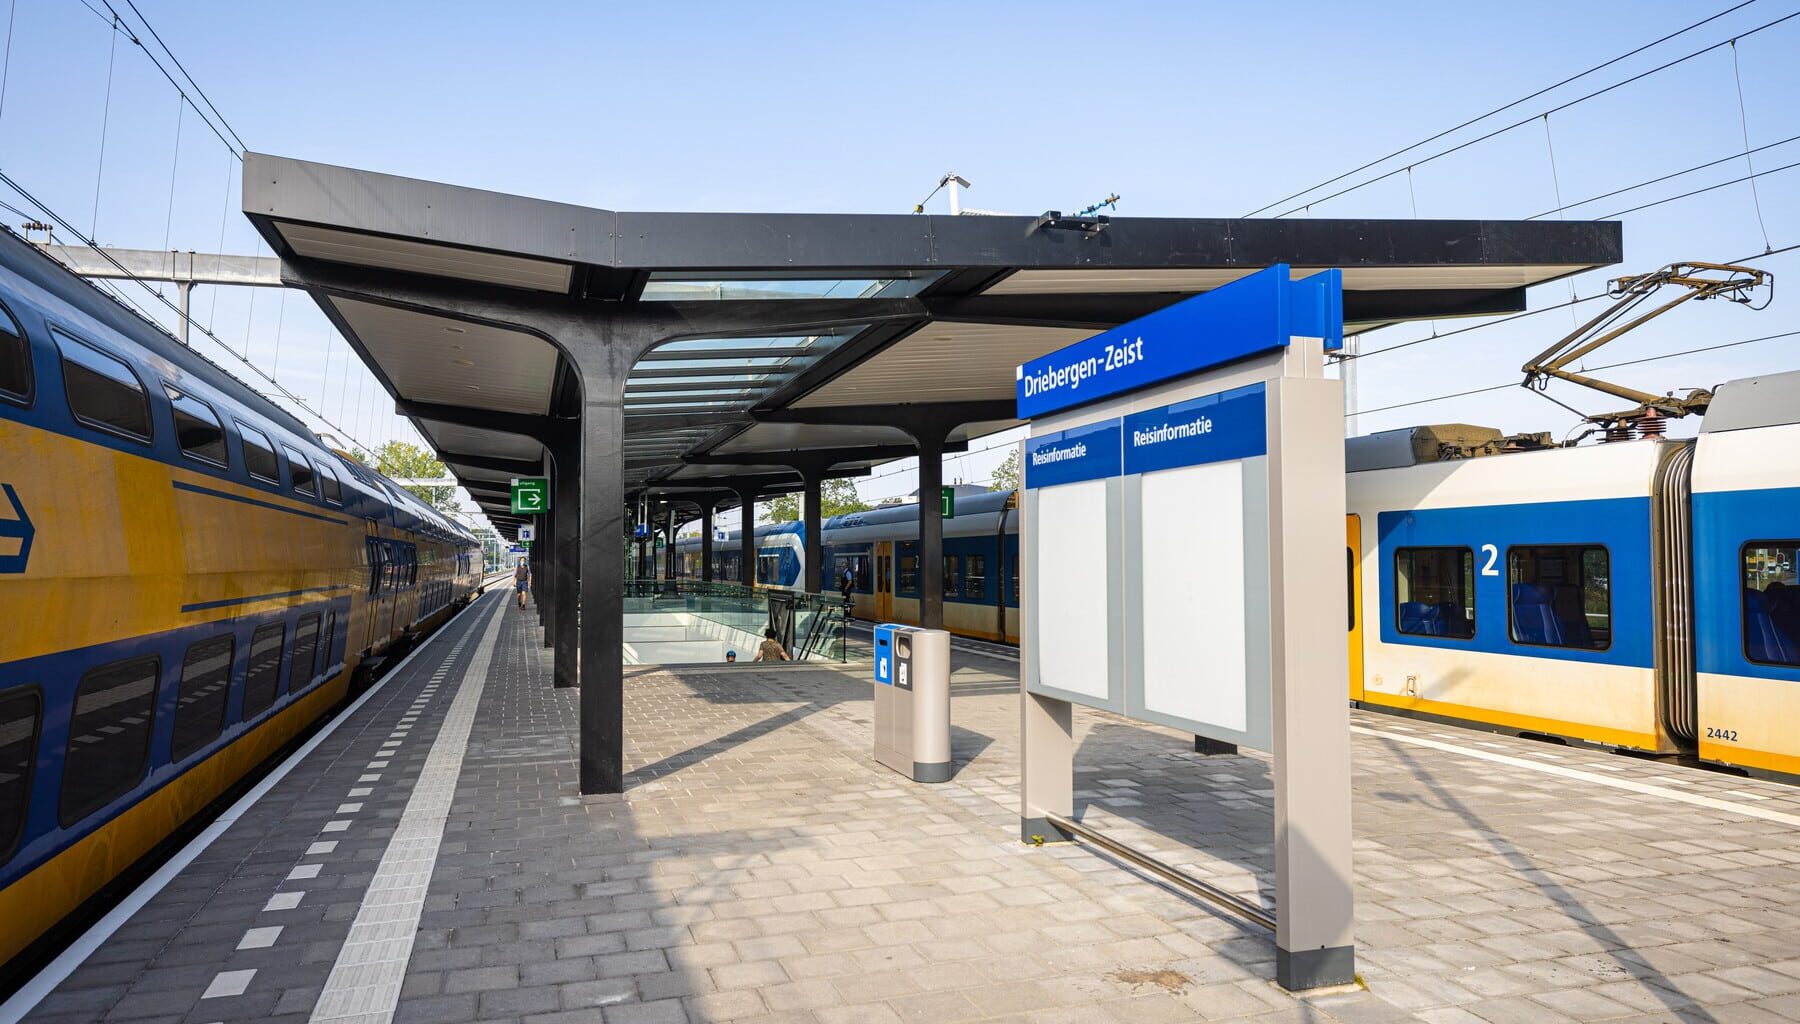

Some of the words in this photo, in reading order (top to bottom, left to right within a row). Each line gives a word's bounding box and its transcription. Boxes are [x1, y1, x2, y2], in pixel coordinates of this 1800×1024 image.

[1024, 336, 1144, 398] Driebergen-Zeist
[1133, 416, 1212, 447] Reisinformatie
[1032, 442, 1087, 466] Reisinformatie
[1481, 543, 1499, 576] 2
[1706, 727, 1738, 742] 2442
